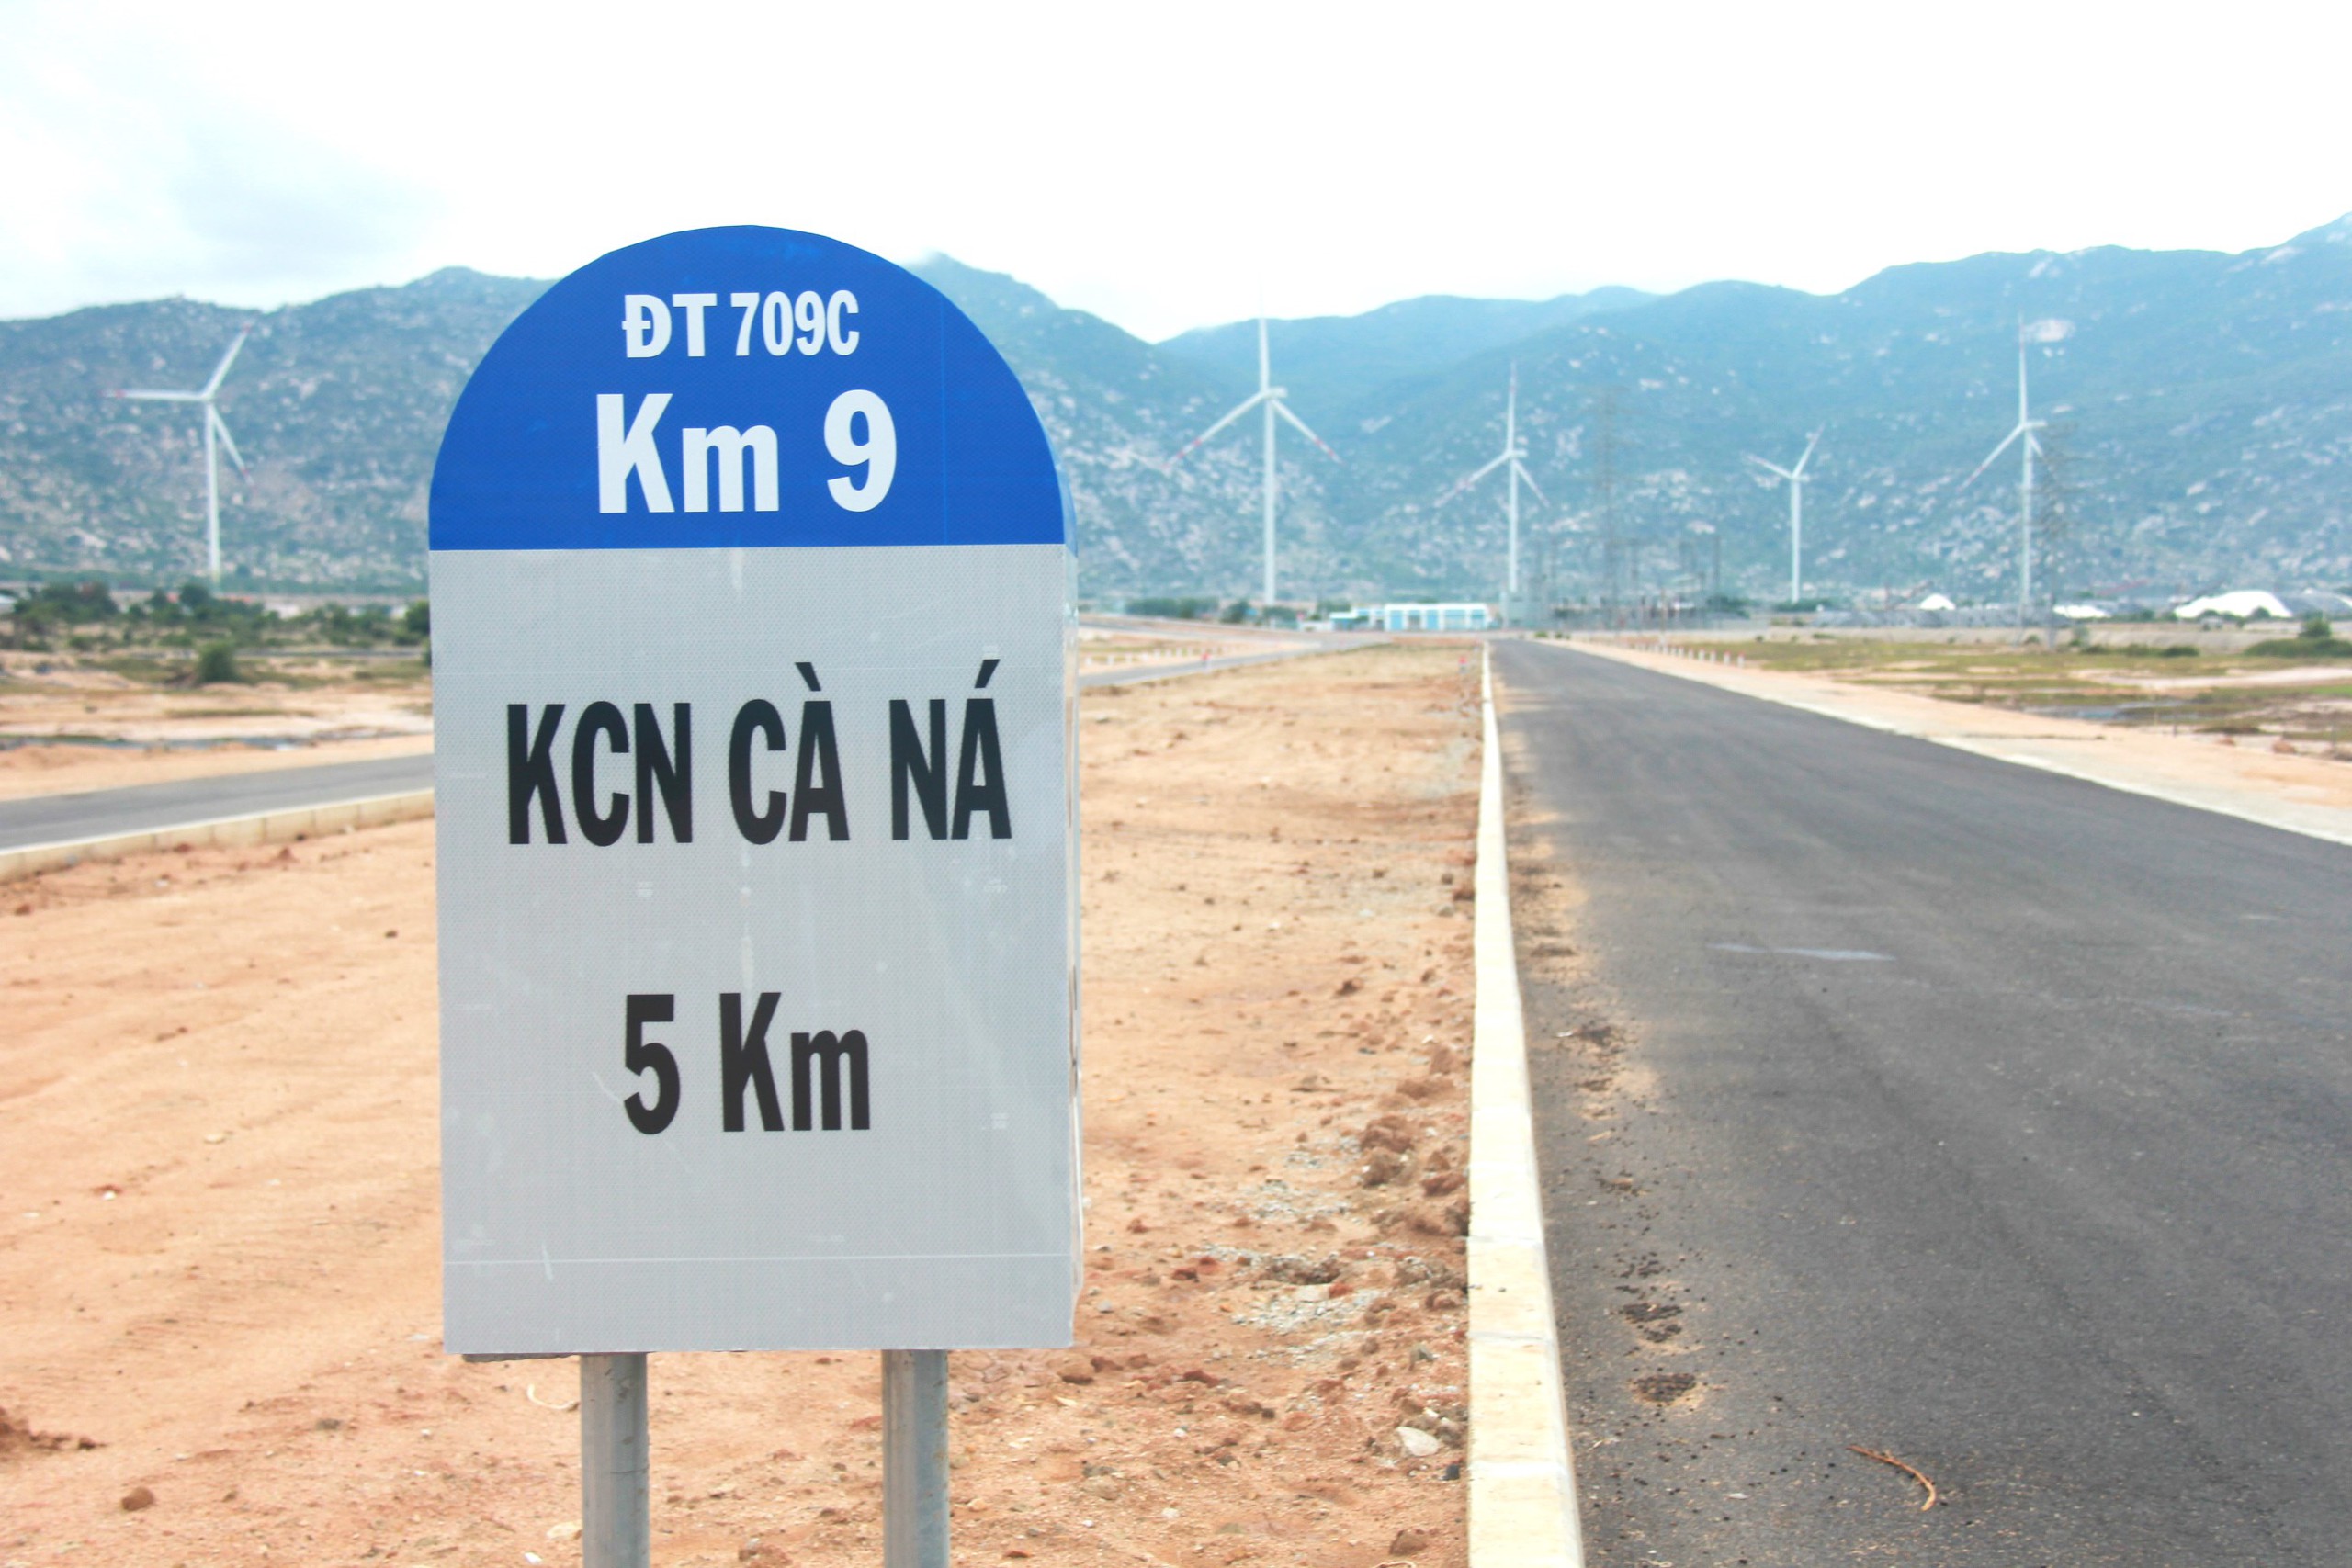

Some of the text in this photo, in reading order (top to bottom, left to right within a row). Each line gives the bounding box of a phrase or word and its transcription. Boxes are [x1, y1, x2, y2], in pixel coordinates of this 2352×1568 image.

[622, 289, 860, 358] ĐT 709C
[596, 389, 898, 513] Km 9
[506, 658, 1012, 847] KCN CÀ NÁ
[623, 991, 871, 1135] 5 Km
